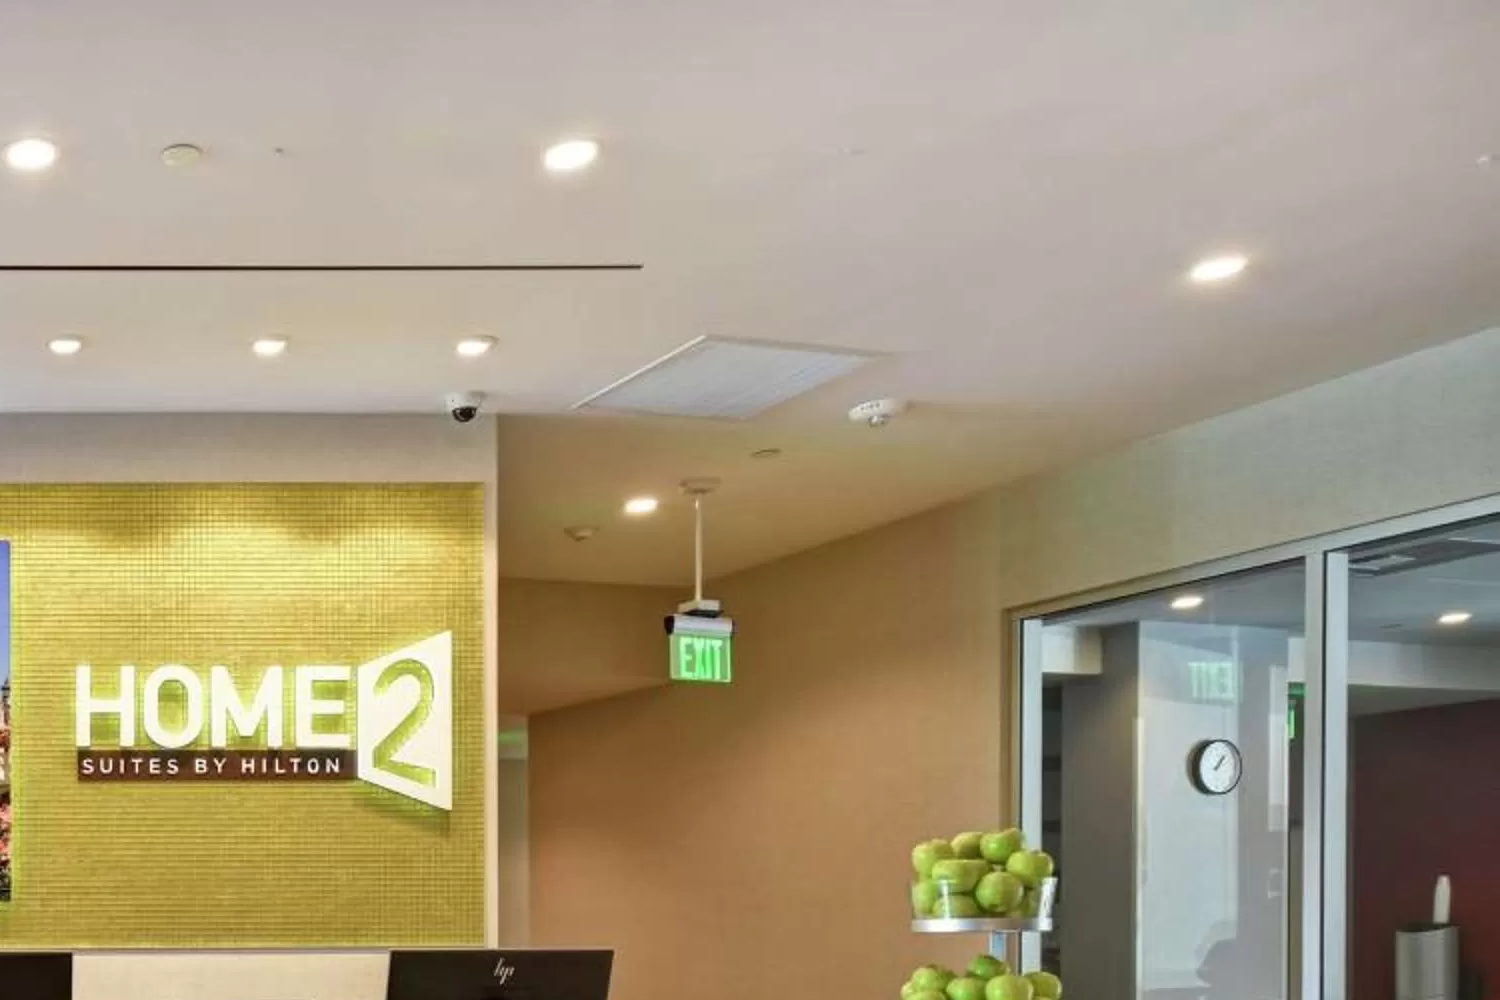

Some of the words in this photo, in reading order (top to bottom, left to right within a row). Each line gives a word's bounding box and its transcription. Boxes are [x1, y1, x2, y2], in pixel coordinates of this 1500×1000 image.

[680, 636, 723, 681] EXIT
[81, 758, 180, 775] SUITES
[195, 758, 226, 774] BY
[241, 757, 341, 774] HILTON
[494, 957, 516, 985] hp
